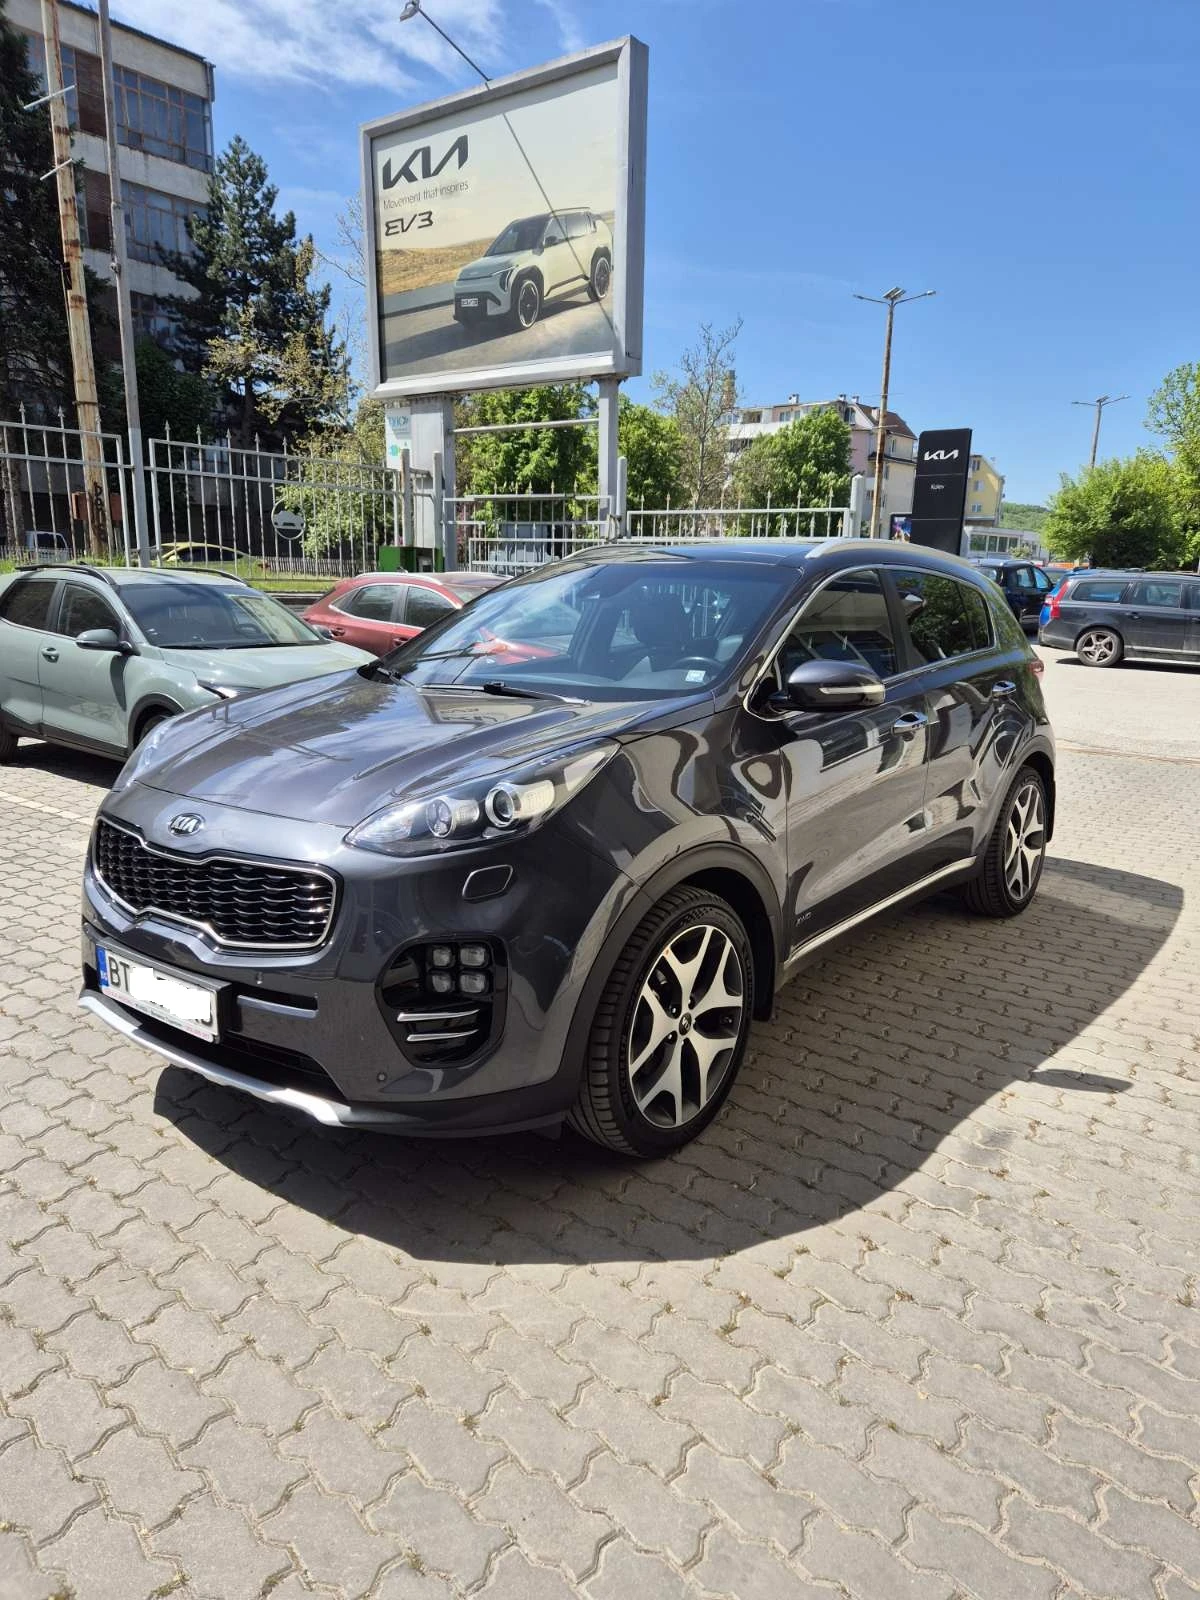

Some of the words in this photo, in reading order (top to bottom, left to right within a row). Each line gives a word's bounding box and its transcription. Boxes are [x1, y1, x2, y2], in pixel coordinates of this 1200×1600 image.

[382, 134, 469, 190] KIA
[383, 191, 421, 210] Movement
[423, 187, 439, 200] that
[440, 181, 470, 196] inspires
[385, 210, 434, 237] EV3
[924, 449, 959, 461] KIA
[170, 815, 200, 833] KIA
